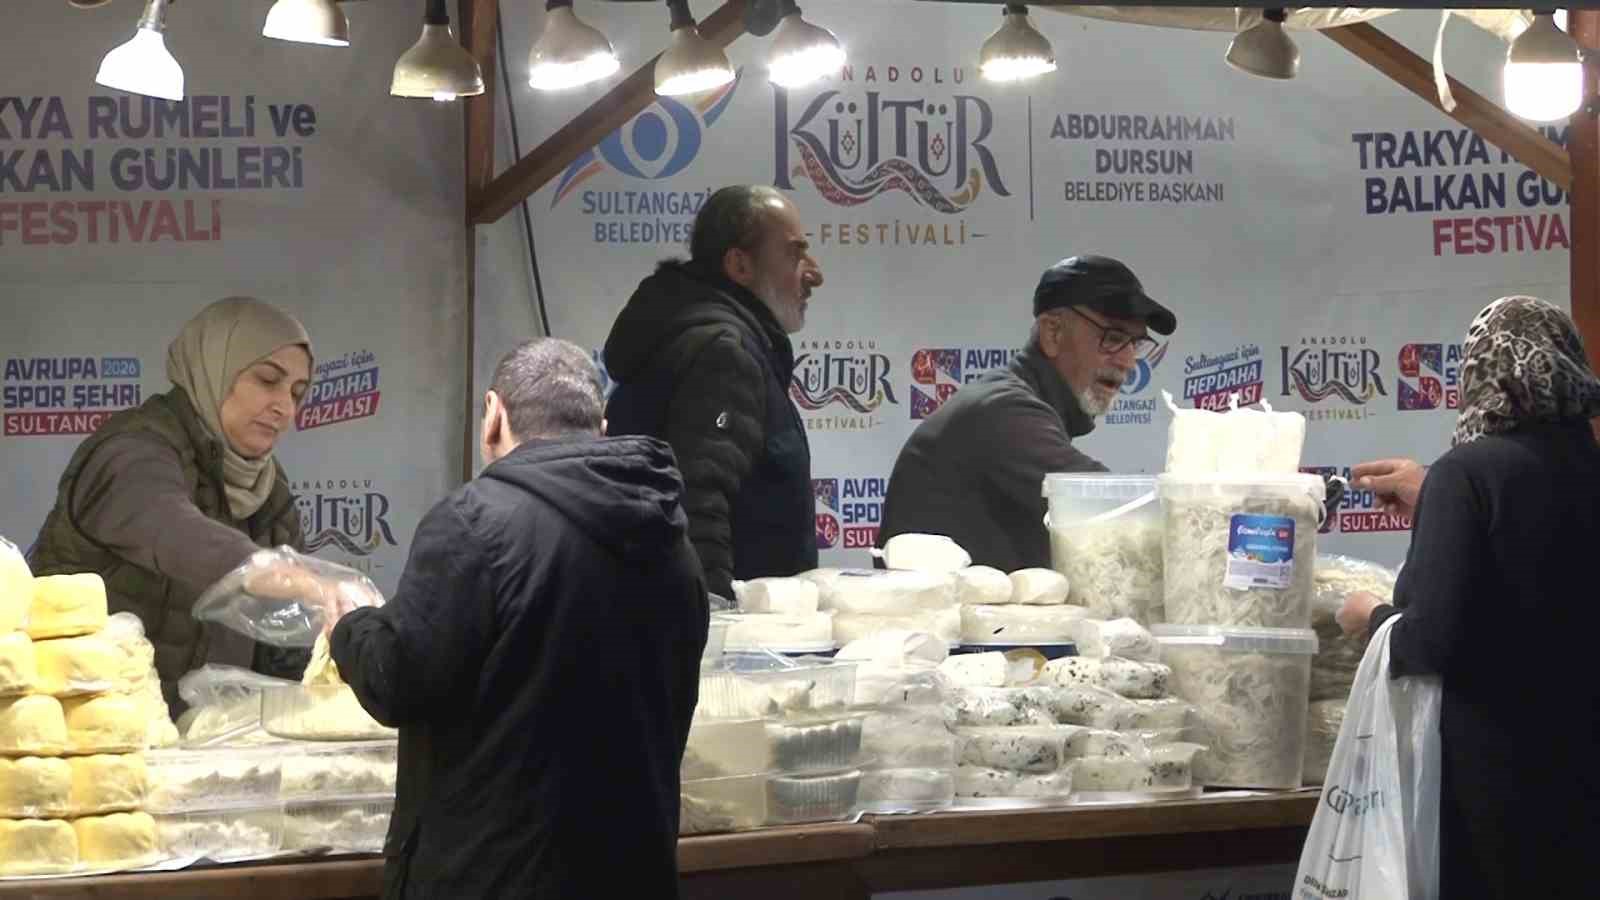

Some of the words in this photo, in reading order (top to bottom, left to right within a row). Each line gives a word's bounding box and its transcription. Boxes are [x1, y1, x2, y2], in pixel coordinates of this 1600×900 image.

[842, 65, 964, 84] NADOLU
[88, 95, 256, 139] RUMELİ
[268, 103, 317, 137] ve
[1050, 113, 1235, 141] ABDURRAHMAN
[769, 83, 1012, 197] KÜLTÜR
[1352, 129, 1490, 170] TRAKYA
[110, 146, 303, 192] GÜNLERİ
[1095, 149, 1193, 175] DURSUN
[582, 187, 711, 215] SULTANGAZ
[1065, 181, 1145, 202] BELEDİYE
[1150, 182, 1224, 204] BAŞKANI
[1365, 172, 1506, 214] BALKAN
[820, 219, 966, 245] FESTİVALİ
[4, 358, 98, 380] AVRUPA
[103, 360, 137, 376] 2026
[1280, 346, 1388, 397] KÜLTÜR
[4, 386, 66, 408] SPOR
[299, 396, 372, 428] FAZLASI
